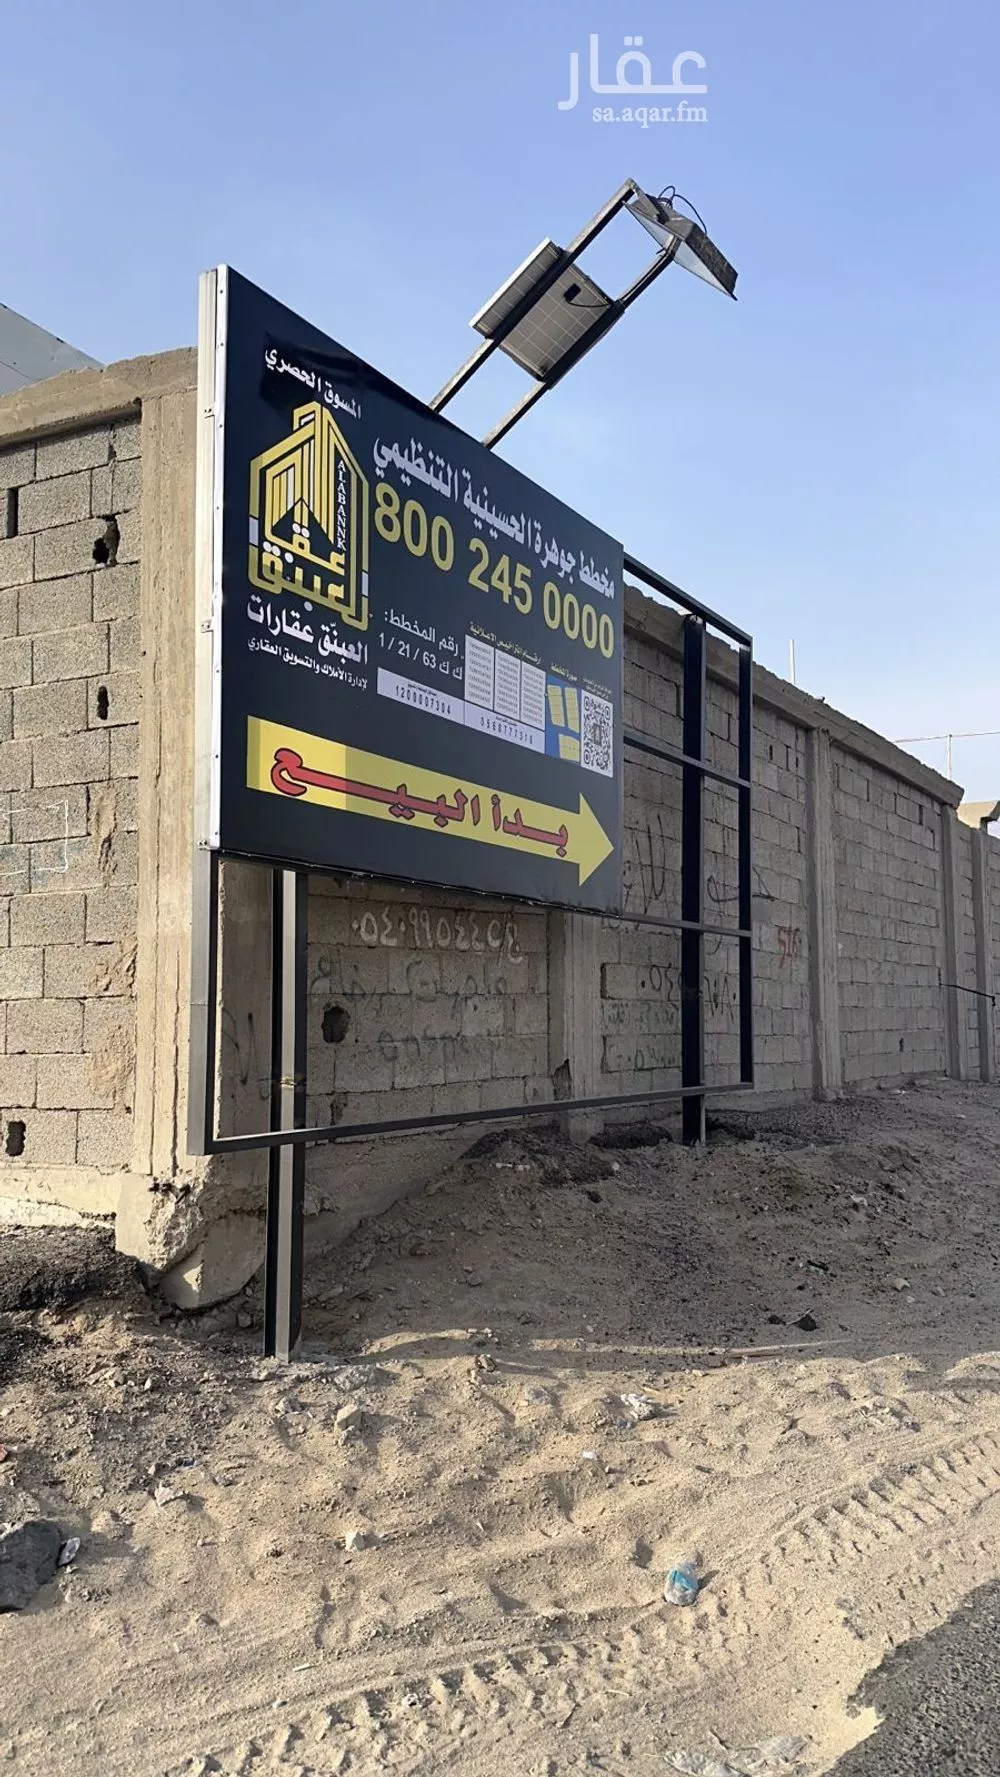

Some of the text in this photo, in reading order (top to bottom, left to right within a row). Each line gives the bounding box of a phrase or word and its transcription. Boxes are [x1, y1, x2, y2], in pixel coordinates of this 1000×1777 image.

[264, 348, 362, 420] المسوق الحصري
[337, 459, 347, 552] ALABANNK
[373, 436, 615, 600] مخطط جوهرة الحسينية التنظيمي
[374, 482, 615, 658] 800 245 0000
[247, 594, 315, 644] عقارات
[384, 608, 459, 657] رقم المخطط:
[248, 637, 282, 656] العقاري
[282, 647, 320, 674] والتسويق
[398, 641, 410, 658] 21
[423, 651, 436, 669] 63
[439, 661, 449, 675] ك
[452, 666, 463, 680] ك
[270, 747, 569, 857] بدأ البيع
